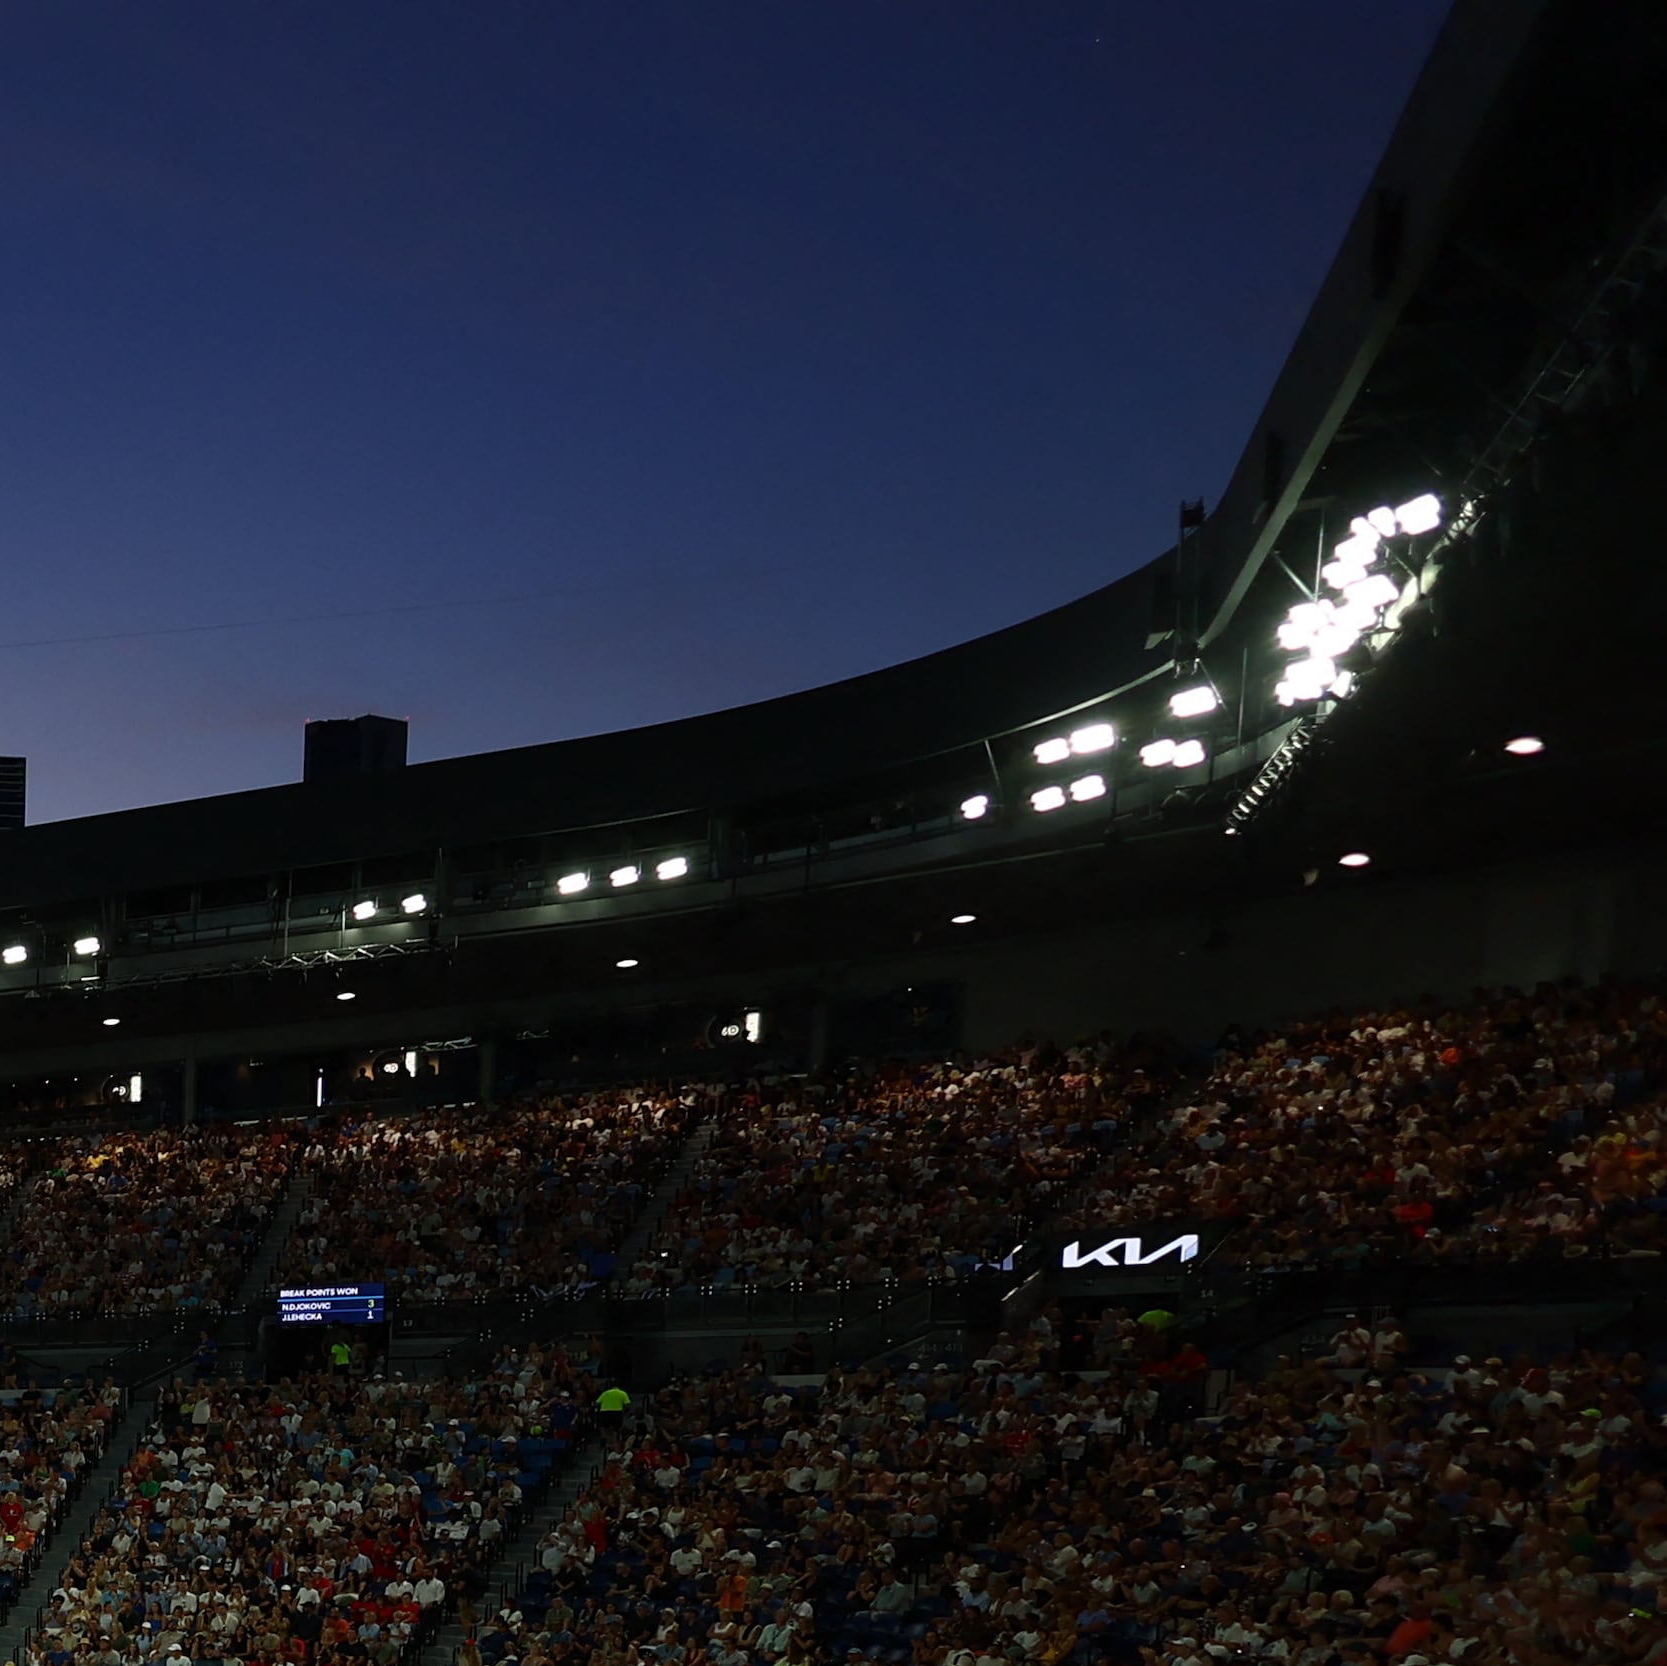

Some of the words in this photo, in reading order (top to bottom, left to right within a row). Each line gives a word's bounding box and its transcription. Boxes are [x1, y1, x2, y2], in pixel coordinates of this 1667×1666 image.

[1063, 1234, 1198, 1268] KIA
[280, 1290, 305, 1298] BREAK
[307, 1288, 335, 1296] POINTS
[336, 1287, 358, 1296] WON
[368, 1299, 375, 1308] 3
[367, 1310, 374, 1319] 1
